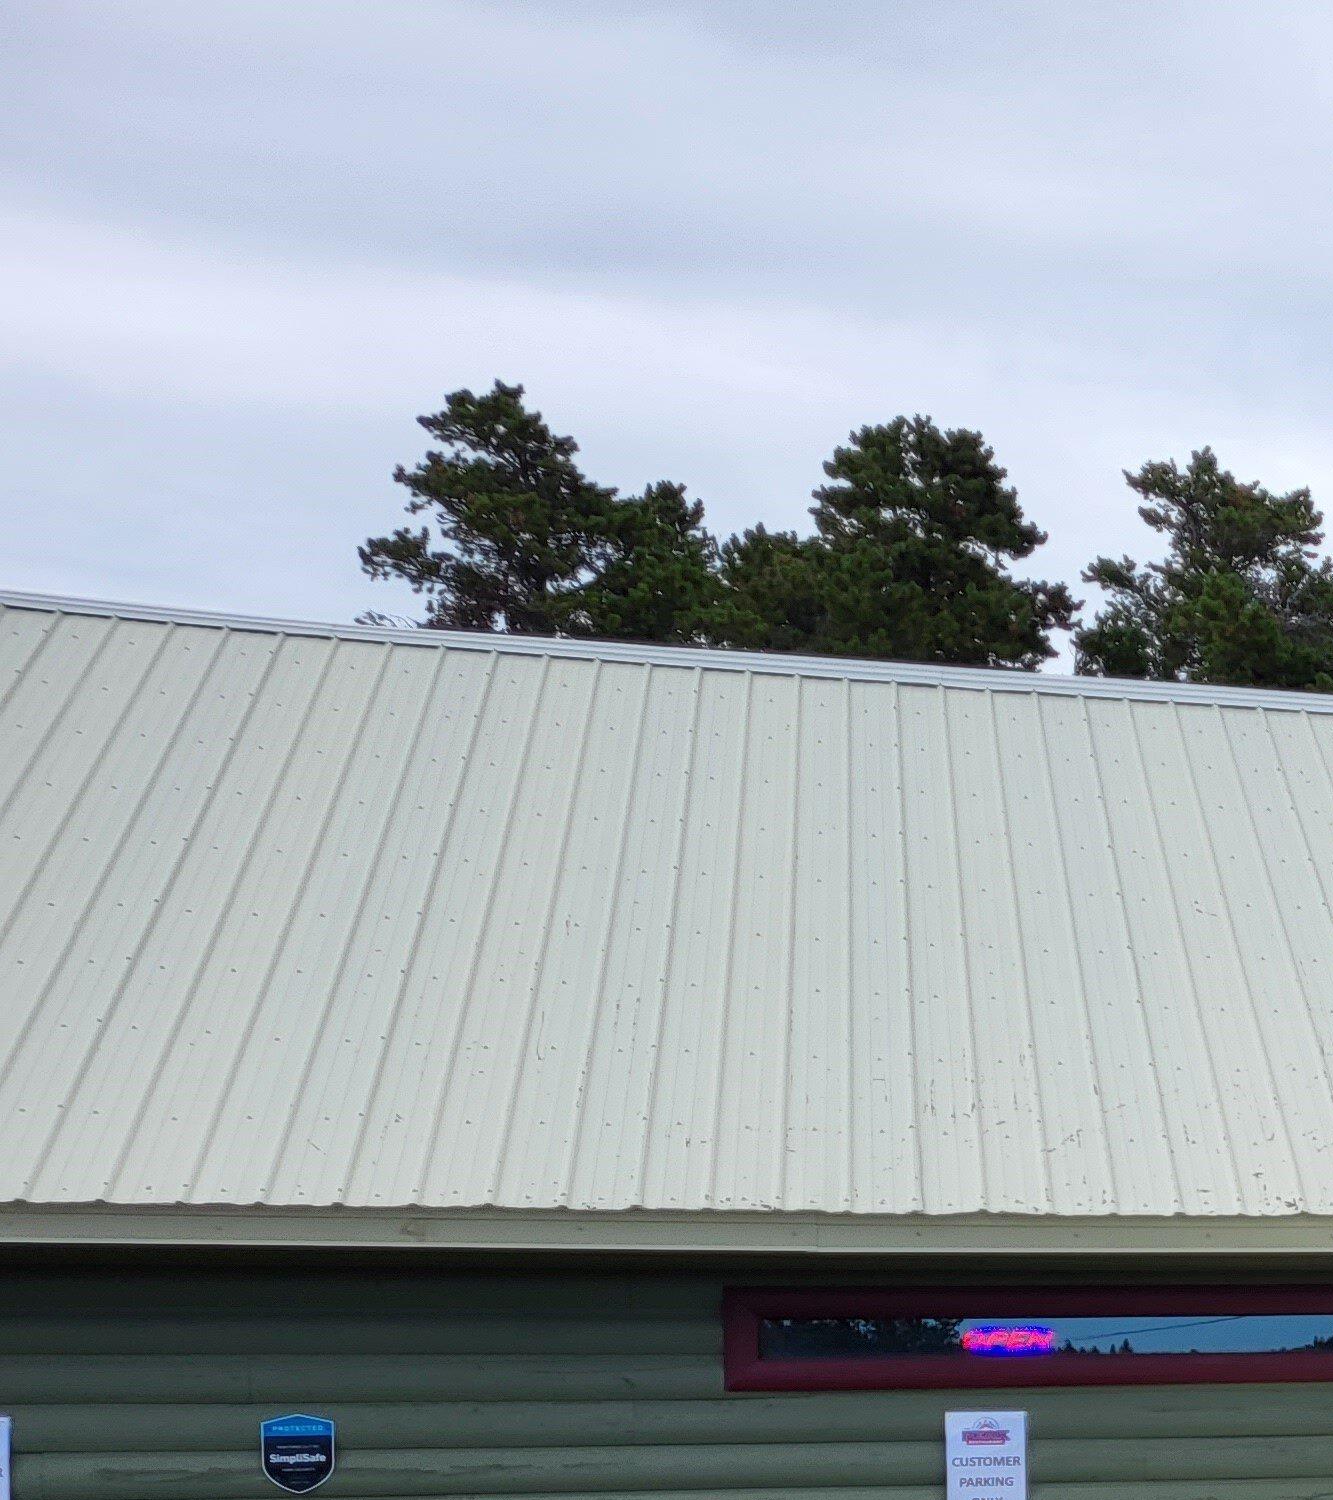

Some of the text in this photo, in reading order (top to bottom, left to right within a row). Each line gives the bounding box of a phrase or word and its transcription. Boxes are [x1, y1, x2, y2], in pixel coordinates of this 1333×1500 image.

[962, 1328, 1053, 1350] OPEN
[269, 1453, 327, 1465] SimpliSafe
[952, 1456, 1022, 1467] CUSTOMER
[960, 1476, 1015, 1488] PARKING
